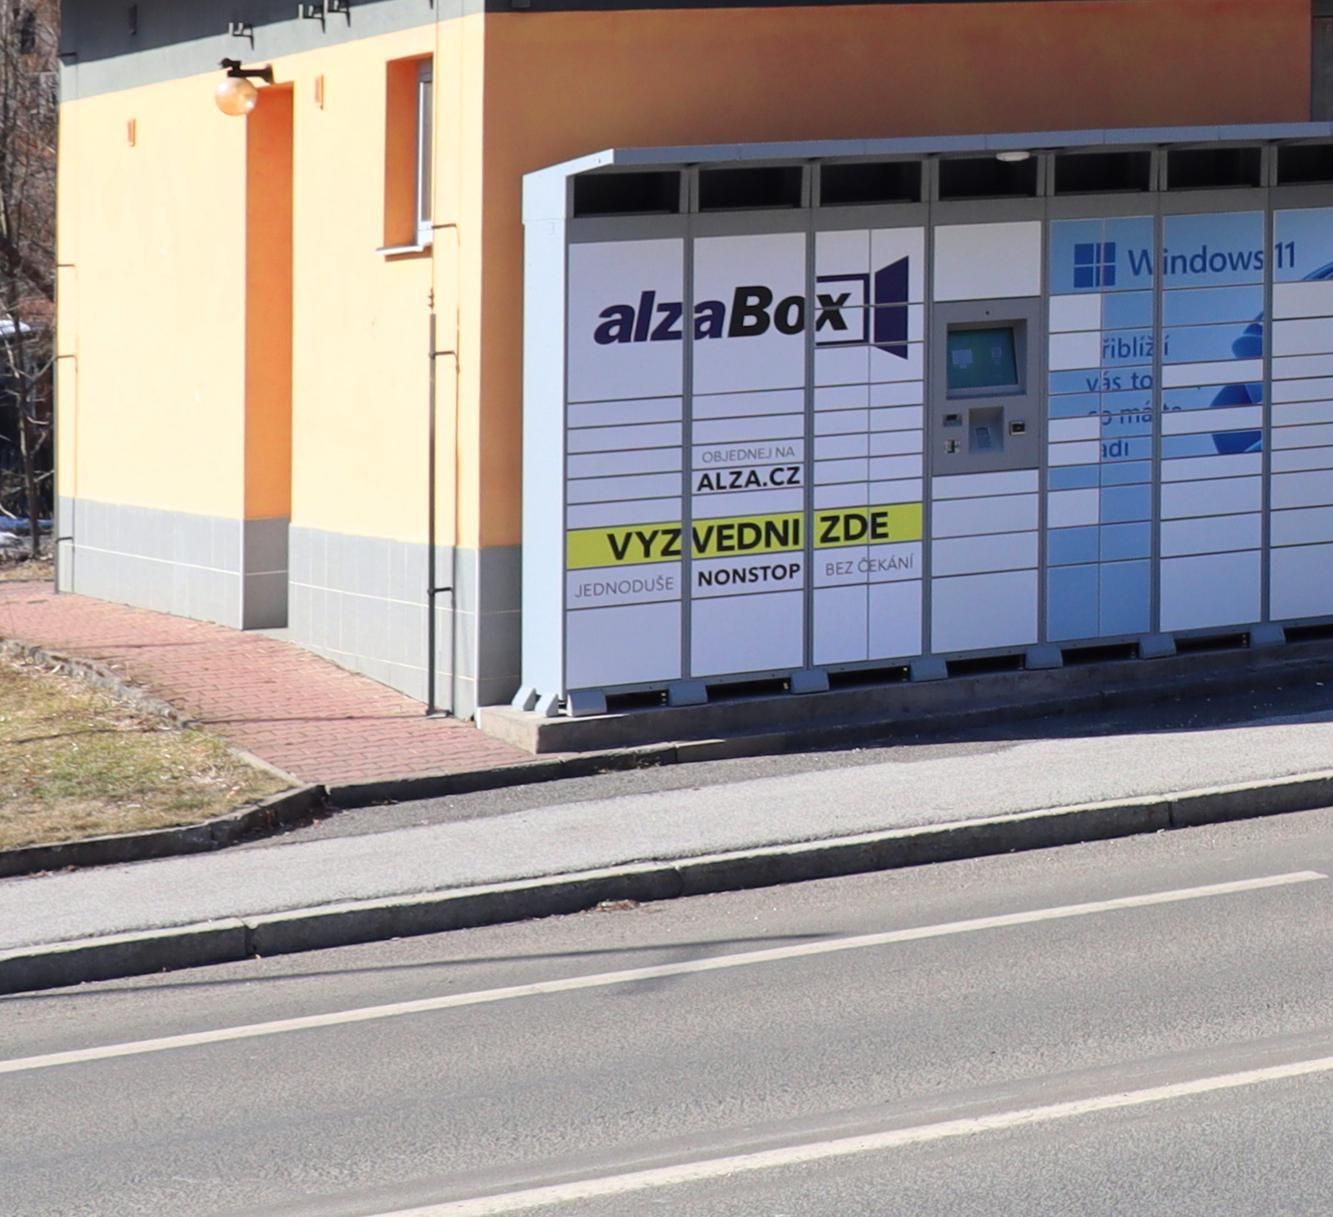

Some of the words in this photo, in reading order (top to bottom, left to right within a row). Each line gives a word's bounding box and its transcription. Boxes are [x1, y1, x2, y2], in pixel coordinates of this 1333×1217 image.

[1128, 245, 1264, 276] Windows
[1275, 241, 1296, 269] 11
[593, 285, 852, 345] alzaBox
[702, 448, 772, 464] OBJEDNEJ
[774, 446, 795, 459] NA
[696, 466, 801, 491] ALZA.CZ
[606, 518, 800, 561] VYZVEDNI
[820, 512, 889, 543] ZDE
[697, 564, 801, 587] NONSTOP
[825, 561, 853, 576] BEZ
[857, 553, 914, 573] ČEKÁNÍ
[574, 577, 674, 598] JEDNODUŠE
